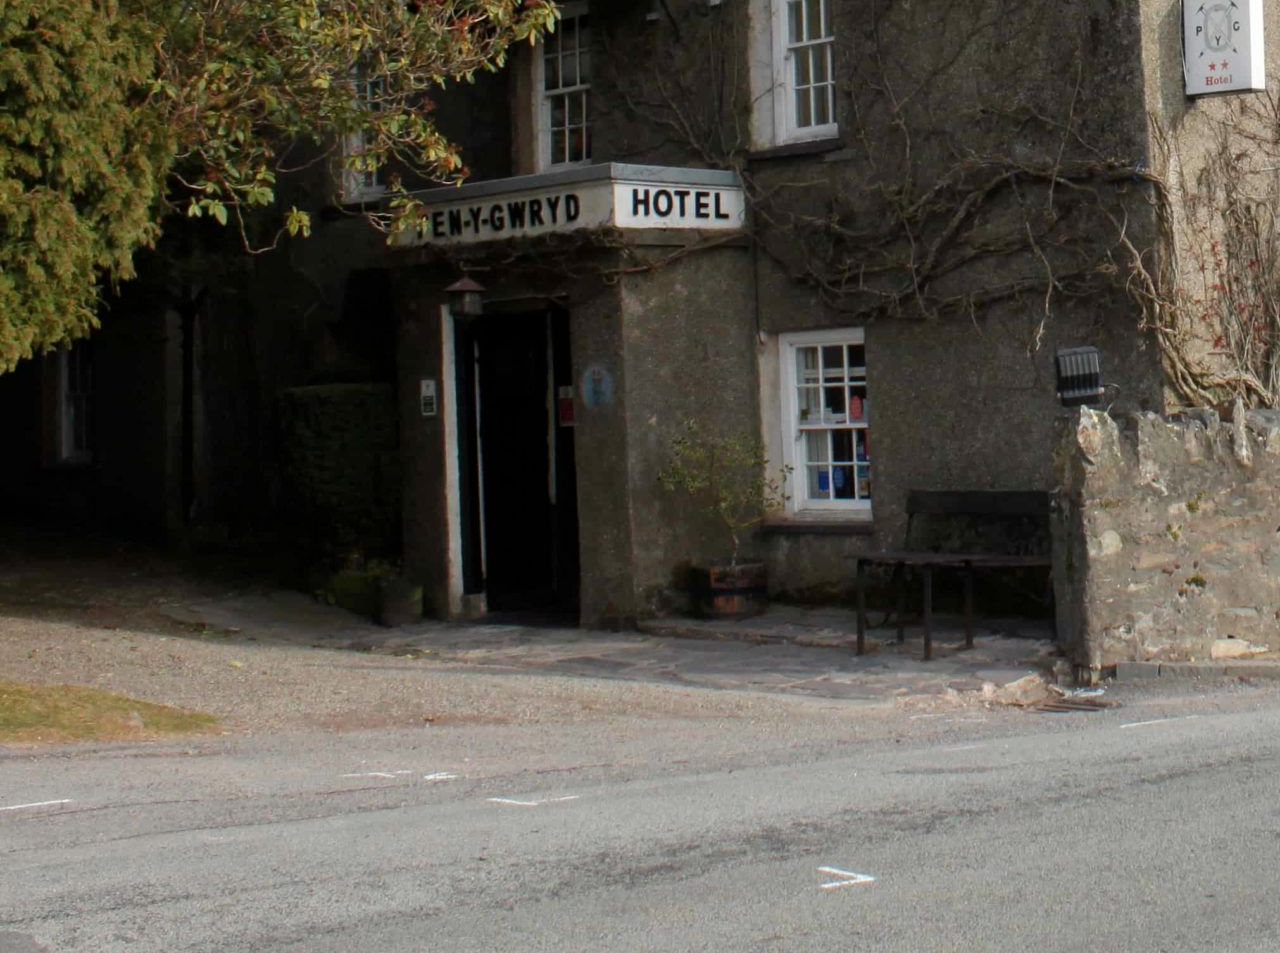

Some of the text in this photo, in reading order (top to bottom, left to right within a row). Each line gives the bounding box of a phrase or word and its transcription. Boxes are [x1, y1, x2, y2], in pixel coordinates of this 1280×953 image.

[1196, 26, 1202, 36] P
[1232, 21, 1240, 31] G
[1215, 35, 1221, 46] Y
[1205, 74, 1233, 86] Hotel
[631, 188, 730, 220] HOTEL
